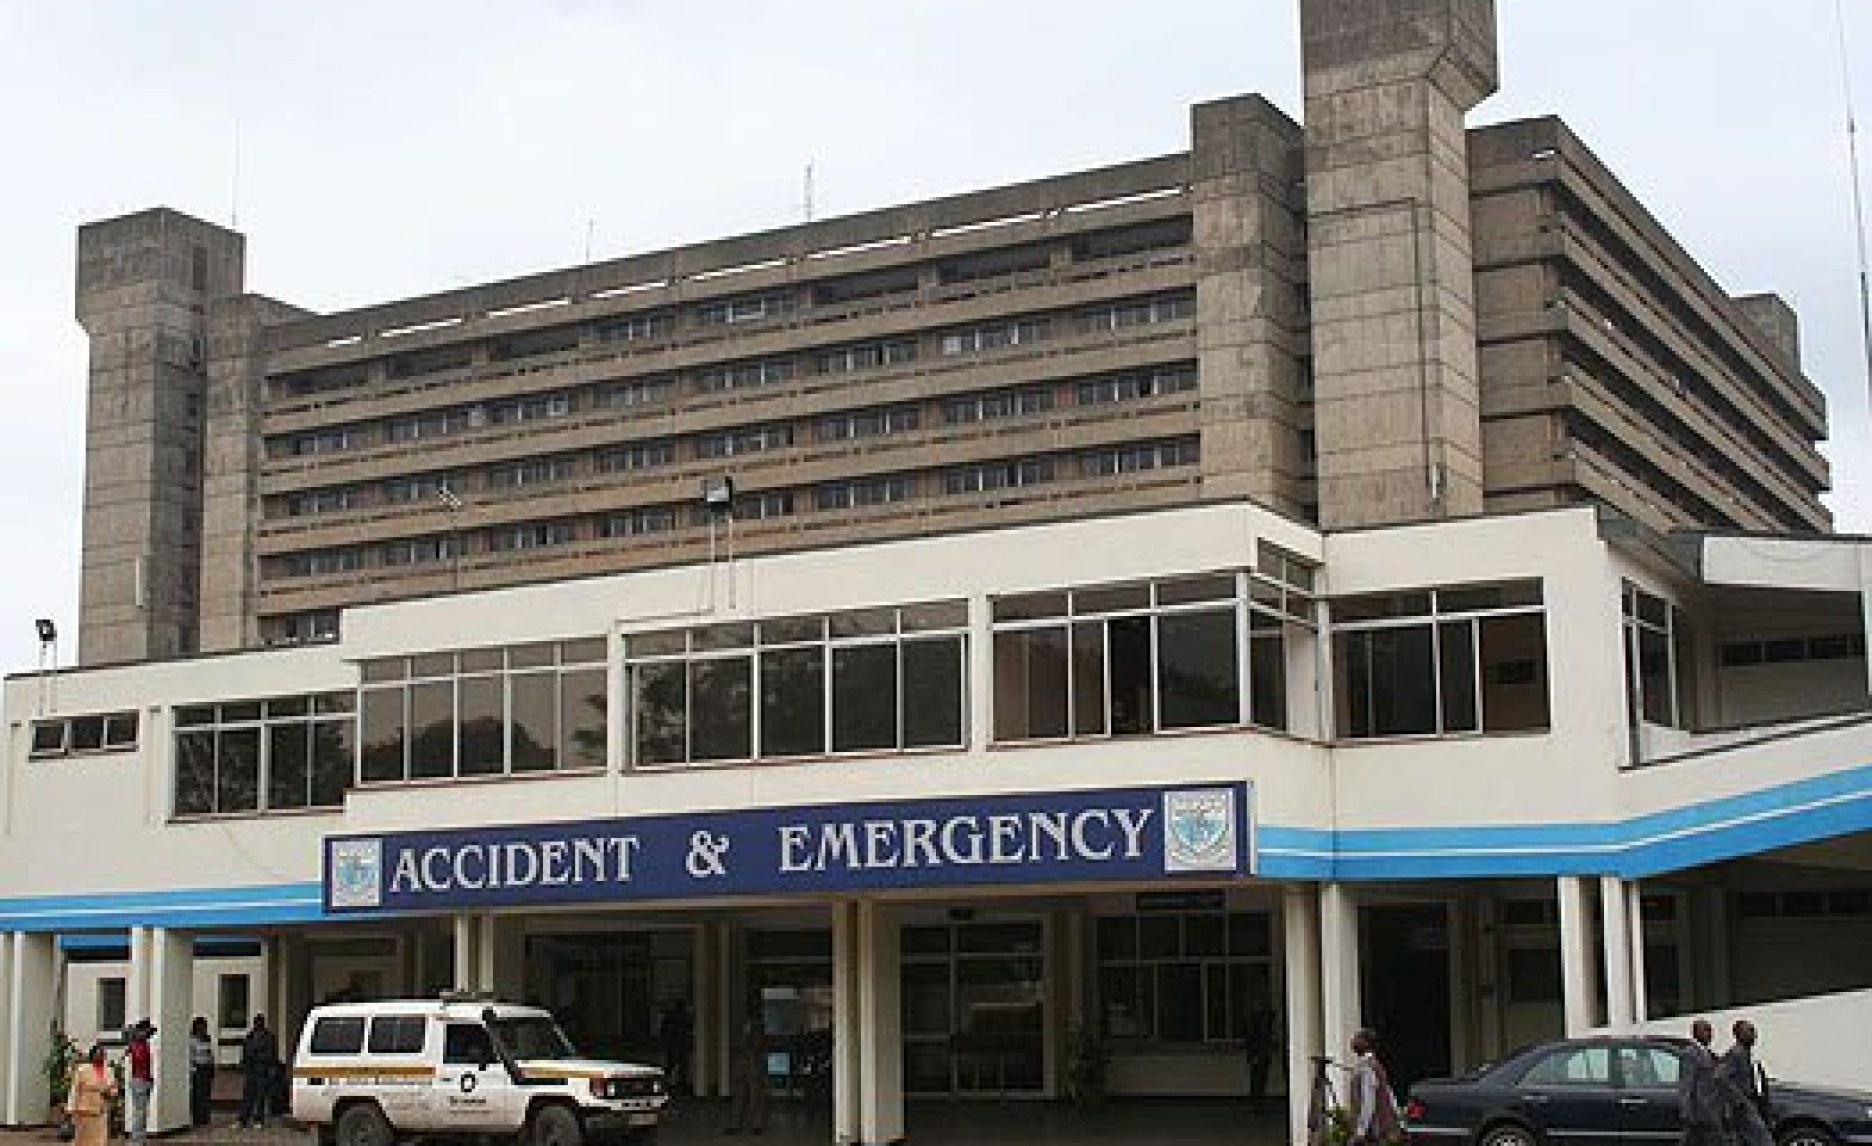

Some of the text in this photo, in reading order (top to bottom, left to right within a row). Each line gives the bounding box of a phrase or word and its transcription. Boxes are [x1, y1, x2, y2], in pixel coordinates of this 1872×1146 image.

[389, 808, 1154, 893] ACCIDENT & EMERGENCY
